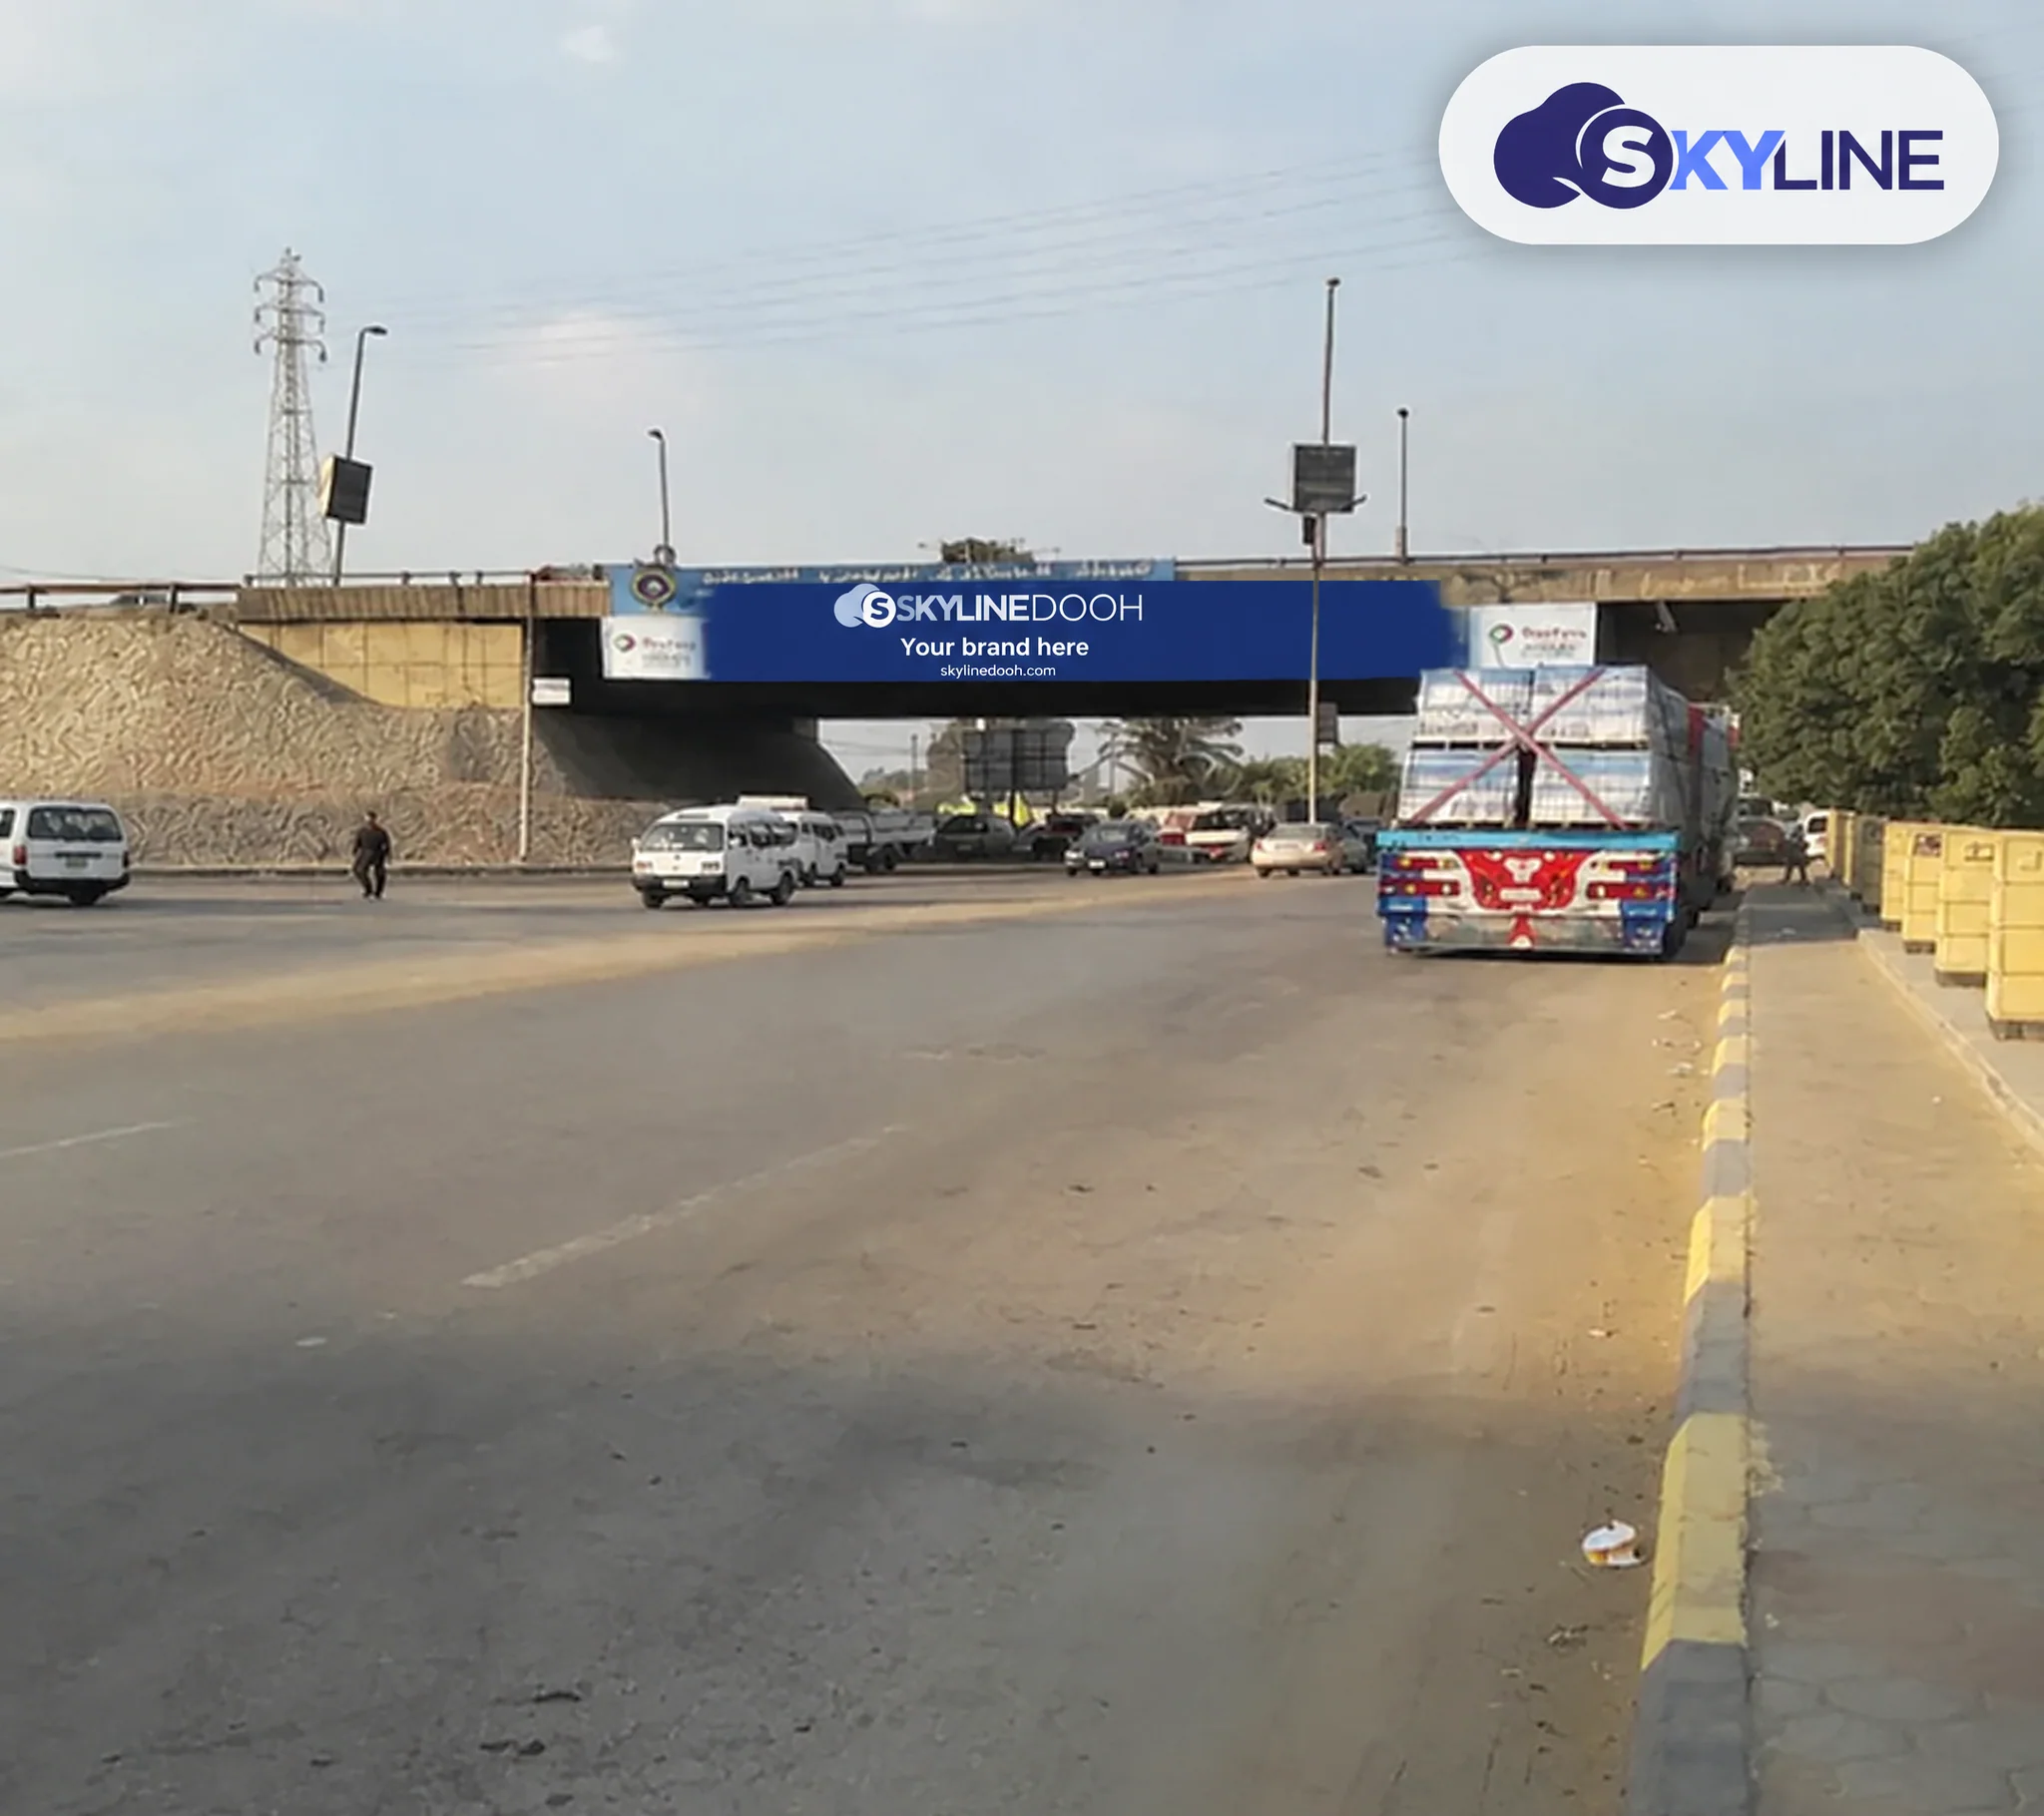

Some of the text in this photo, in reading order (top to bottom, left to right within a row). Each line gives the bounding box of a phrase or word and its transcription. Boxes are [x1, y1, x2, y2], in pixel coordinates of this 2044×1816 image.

[896, 593, 1143, 623] SKYLINEDOOH
[900, 636, 1090, 657] Your brand here
[940, 664, 1056, 680] skylinedooh.com
